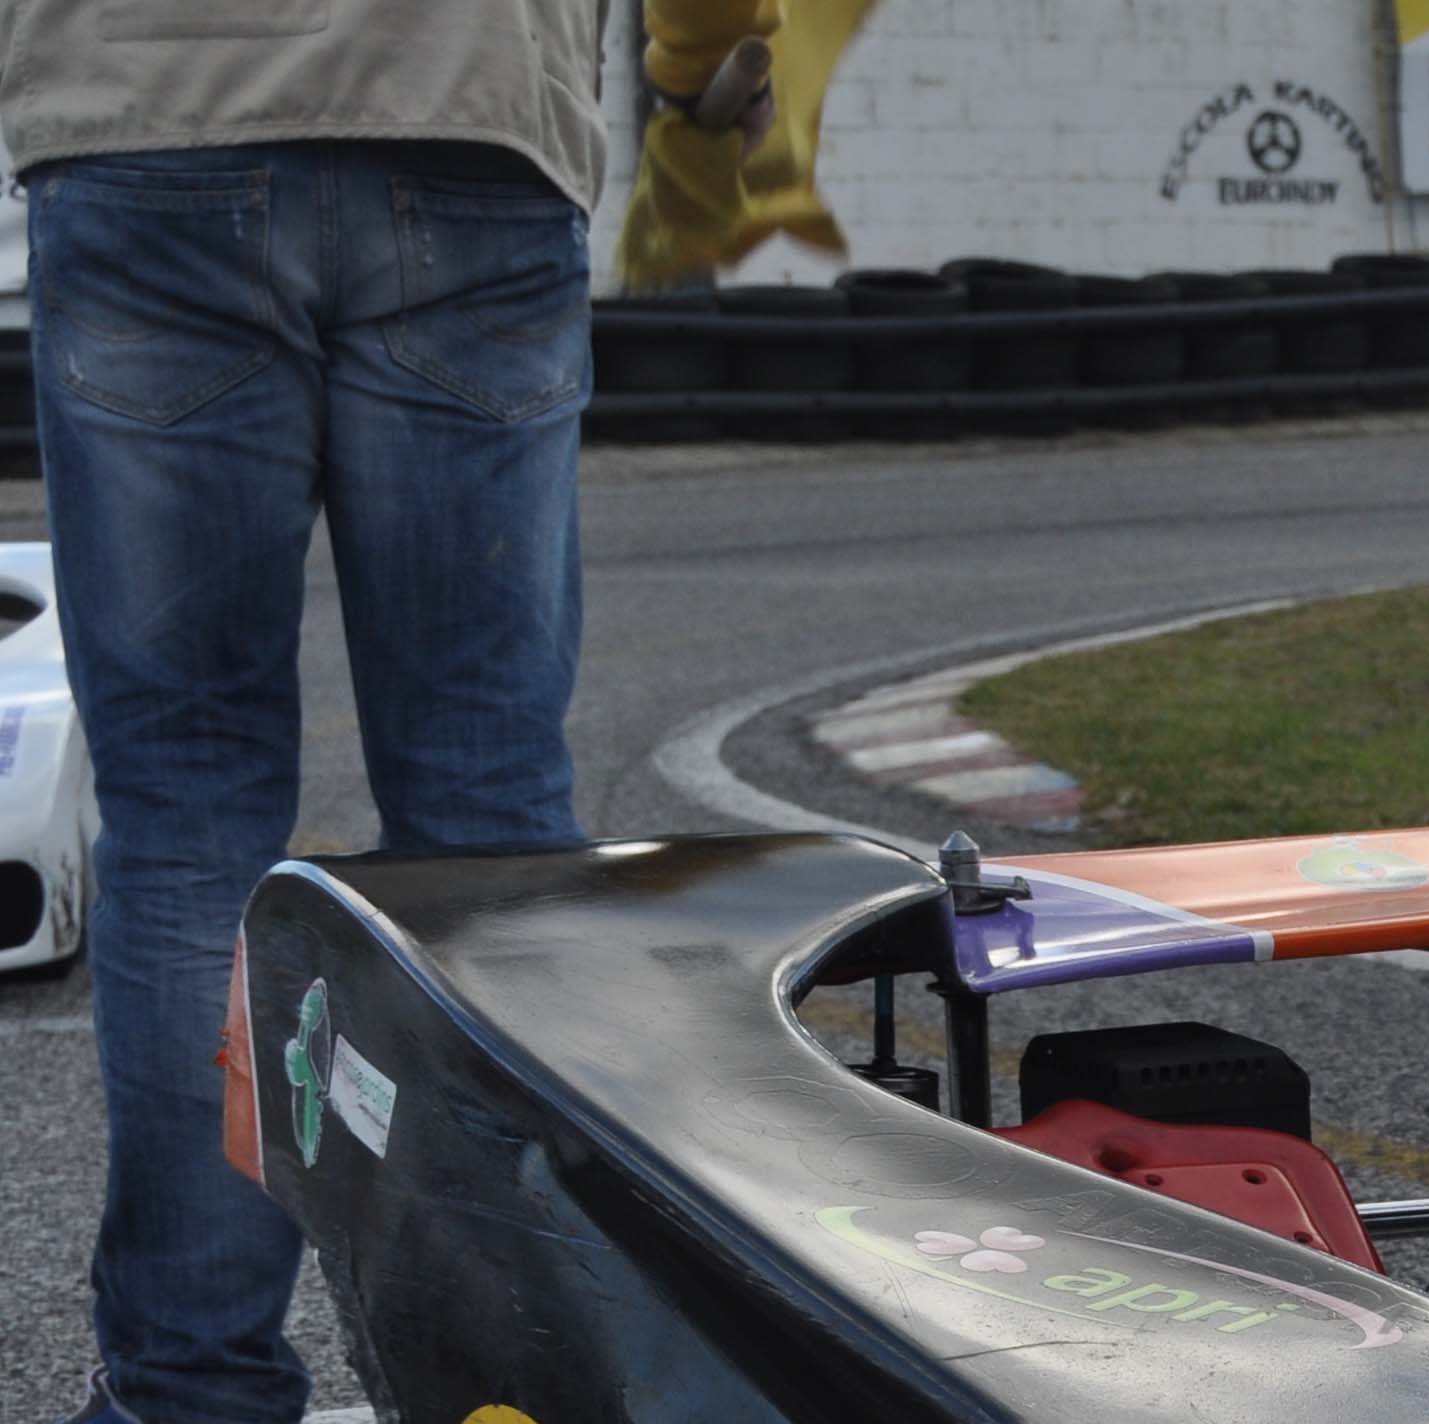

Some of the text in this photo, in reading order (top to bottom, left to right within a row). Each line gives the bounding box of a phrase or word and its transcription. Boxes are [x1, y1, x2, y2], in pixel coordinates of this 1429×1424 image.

[1161, 79, 1387, 204] ESCOLA KARTING
[1218, 178, 1340, 205] EUROINDY
[1042, 1267, 1299, 1334] apri
